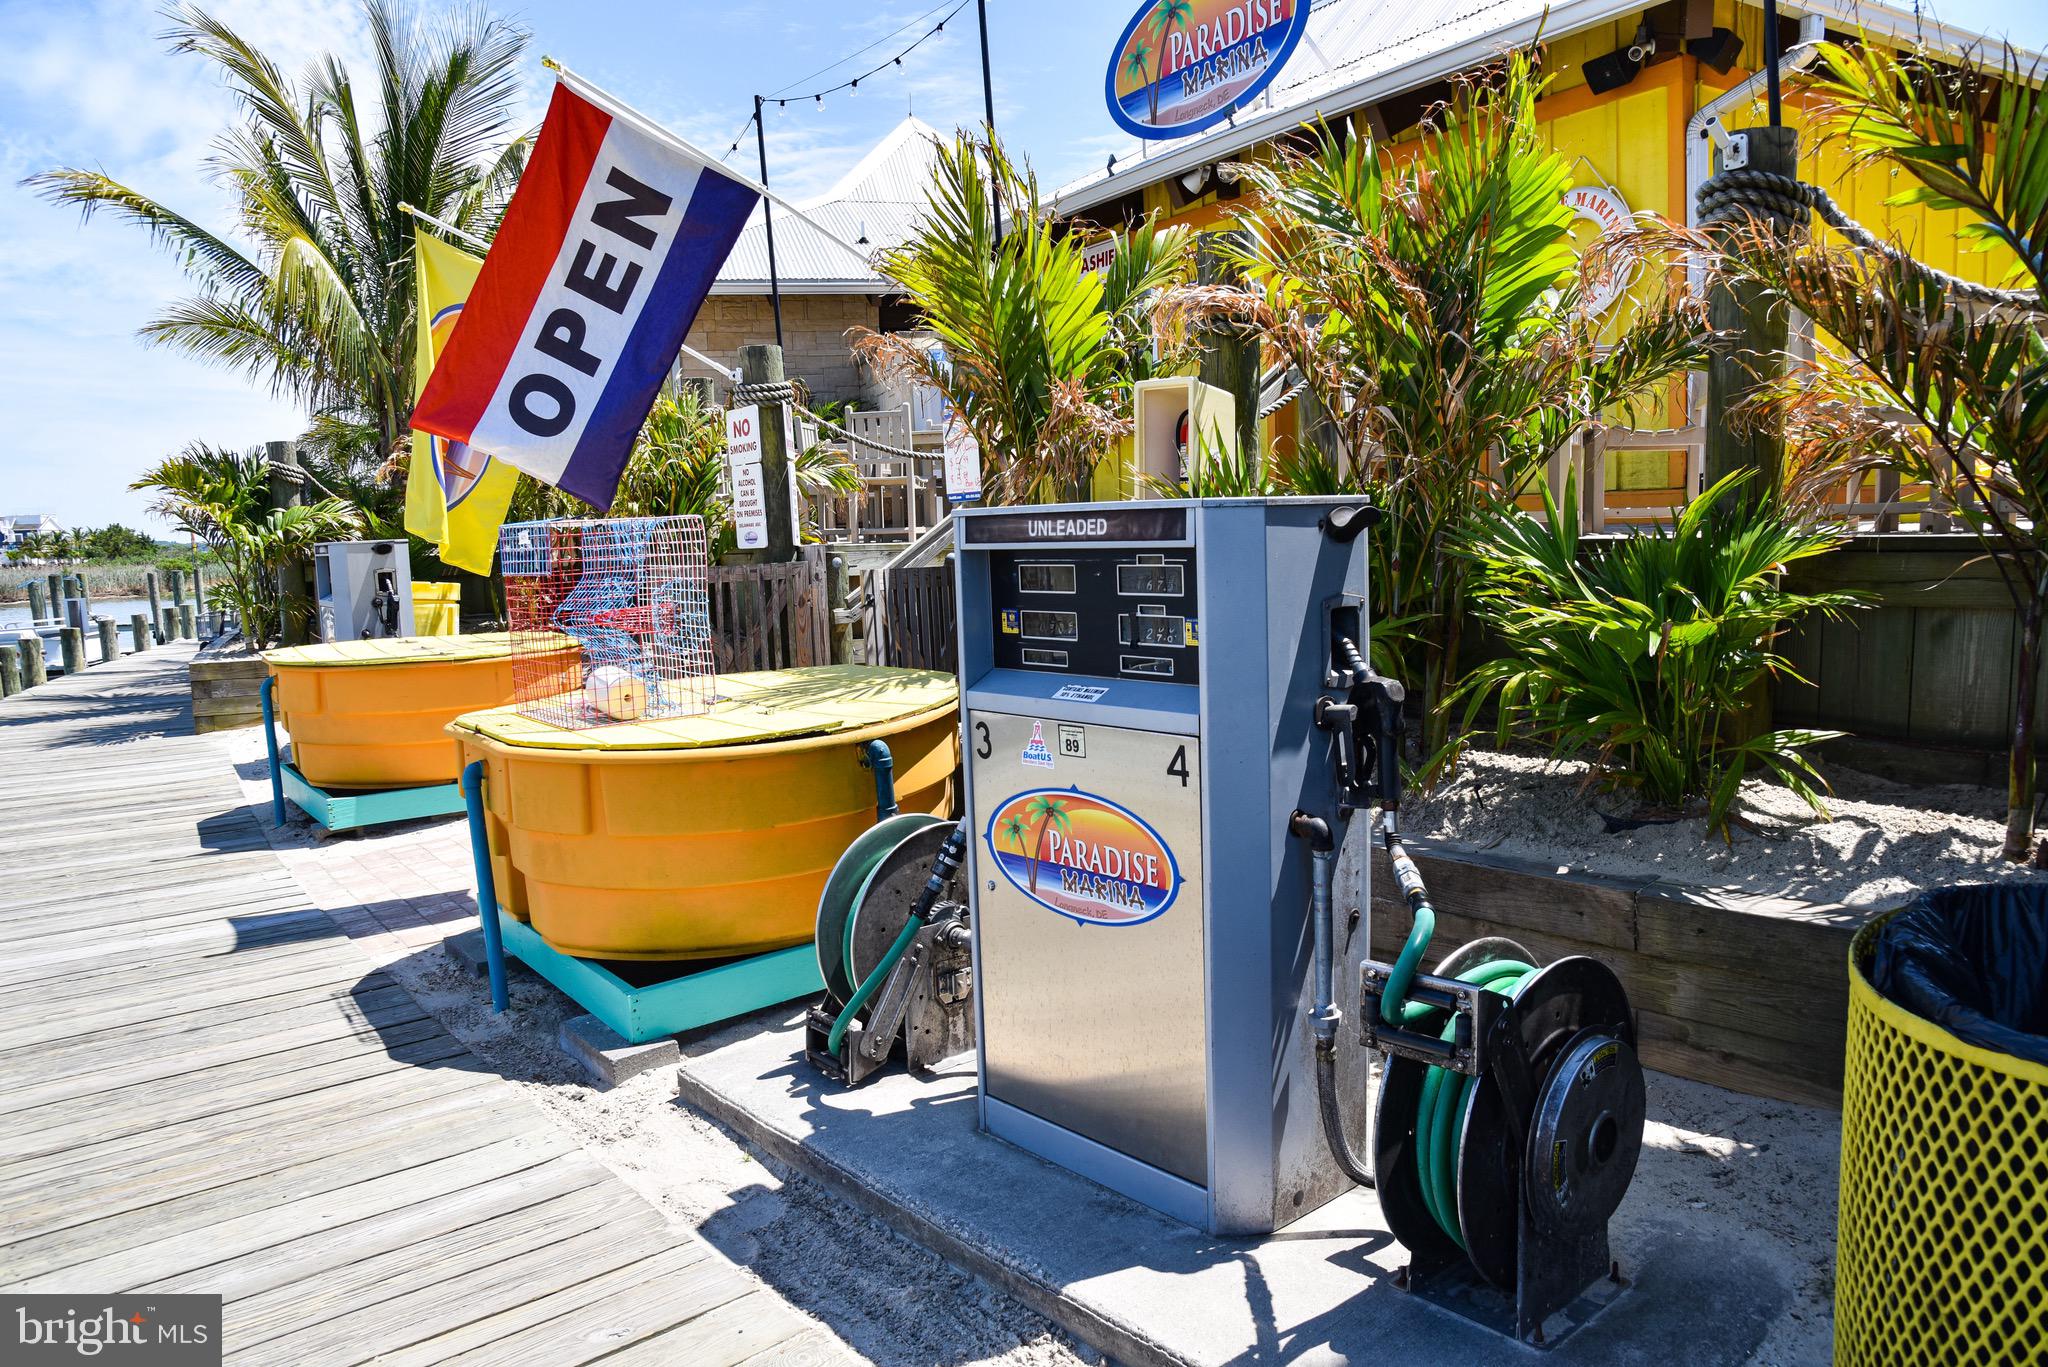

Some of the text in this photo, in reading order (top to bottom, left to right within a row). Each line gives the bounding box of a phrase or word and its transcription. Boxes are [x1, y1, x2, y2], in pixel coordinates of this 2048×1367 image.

[1168, 0, 1282, 74] PARADISE
[1181, 36, 1268, 98] MARINA
[1217, 88, 1230, 104] DE
[1575, 192, 1621, 231] MARIN
[1080, 248, 1115, 274] ASHIE
[508, 166, 673, 438] OPEN
[733, 418, 750, 438] NO
[730, 441, 757, 455] SMOKING
[742, 468, 750, 476] NO
[738, 478, 756, 487] ALCOHOL
[750, 488, 755, 496] BE
[739, 499, 758, 508] BROUGHT
[744, 509, 763, 517] PREMISES
[1028, 518, 1108, 537] UNLEADED
[975, 721, 992, 759] 3
[1065, 738, 1079, 753] 89
[1166, 744, 1190, 787] 4
[1047, 829, 1159, 888] PARADISE
[1061, 869, 1145, 910] MARINA
[1096, 909, 1108, 919] DE
